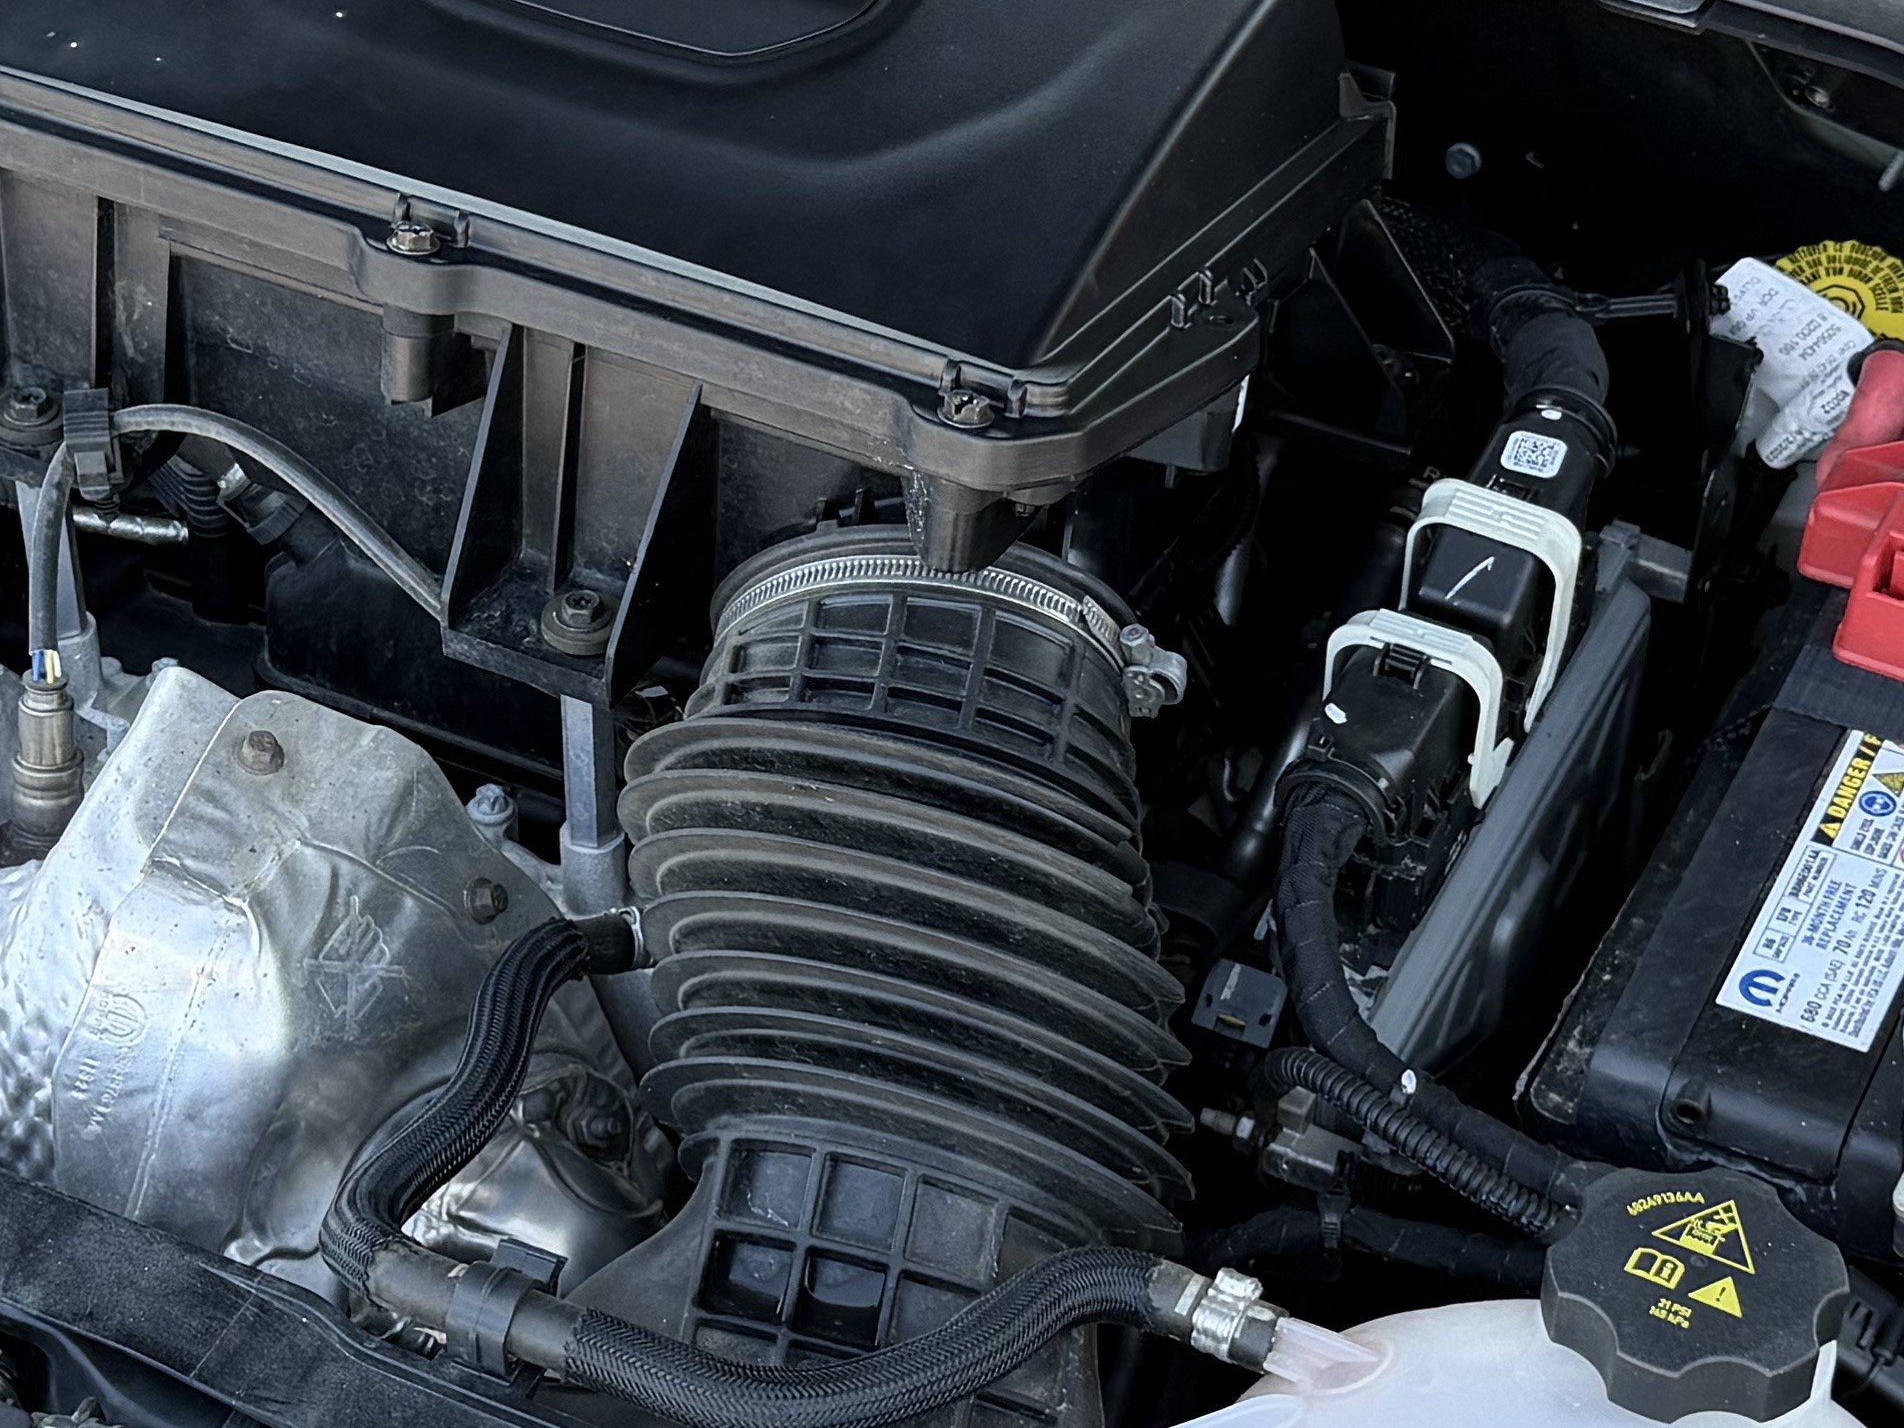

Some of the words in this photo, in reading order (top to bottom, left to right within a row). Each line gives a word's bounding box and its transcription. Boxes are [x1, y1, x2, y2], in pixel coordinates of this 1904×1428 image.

[1825, 754, 1872, 820] DANGER
[1813, 881, 1859, 950] REPLACEMENT
[1823, 877, 1843, 901] FREE
[1798, 997, 1823, 1024] 680
[1831, 937, 1852, 957] 70
[1853, 885, 1877, 912] 120
